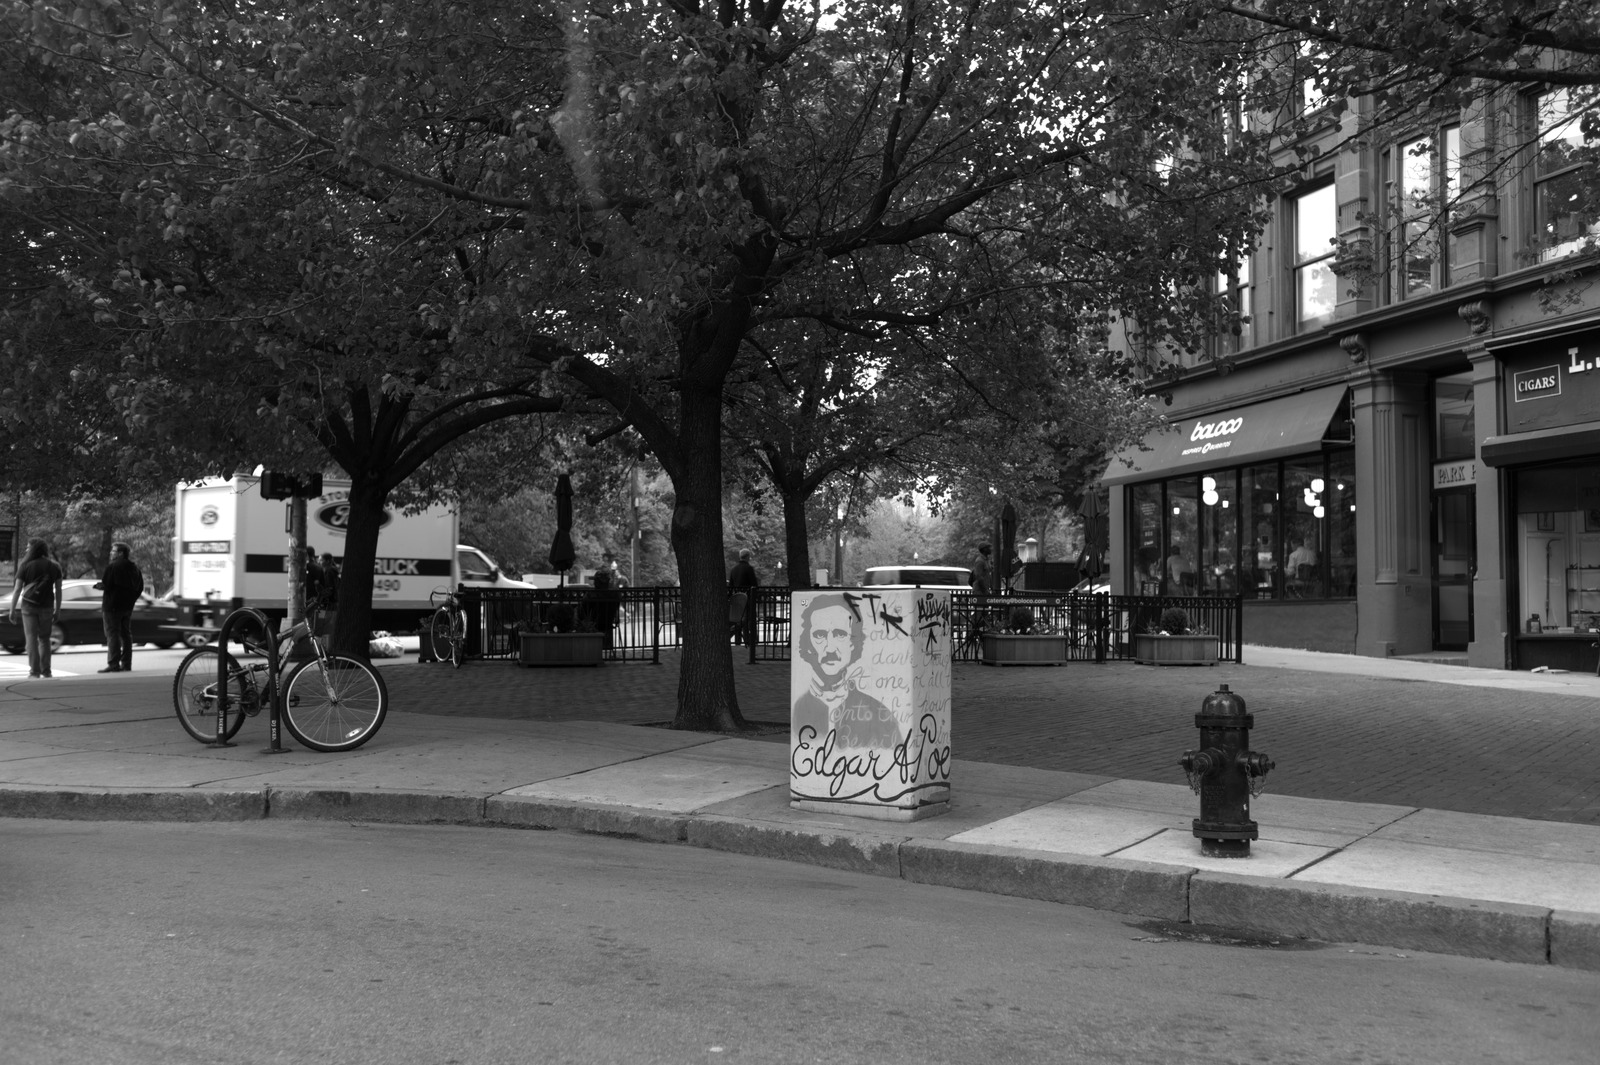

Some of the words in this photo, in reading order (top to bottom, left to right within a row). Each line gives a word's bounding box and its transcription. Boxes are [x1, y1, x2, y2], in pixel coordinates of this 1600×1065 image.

[1568, 347, 1600, 374] L.
[1518, 375, 1556, 393] CIGARS
[1438, 465, 1466, 484] PARK
[374, 559, 419, 575] RUCK
[373, 579, 401, 591] 490
[986, 597, 1047, 606] catering@boloco.com
[875, 674, 910, 693] one,
[791, 725, 882, 797] Edgar
